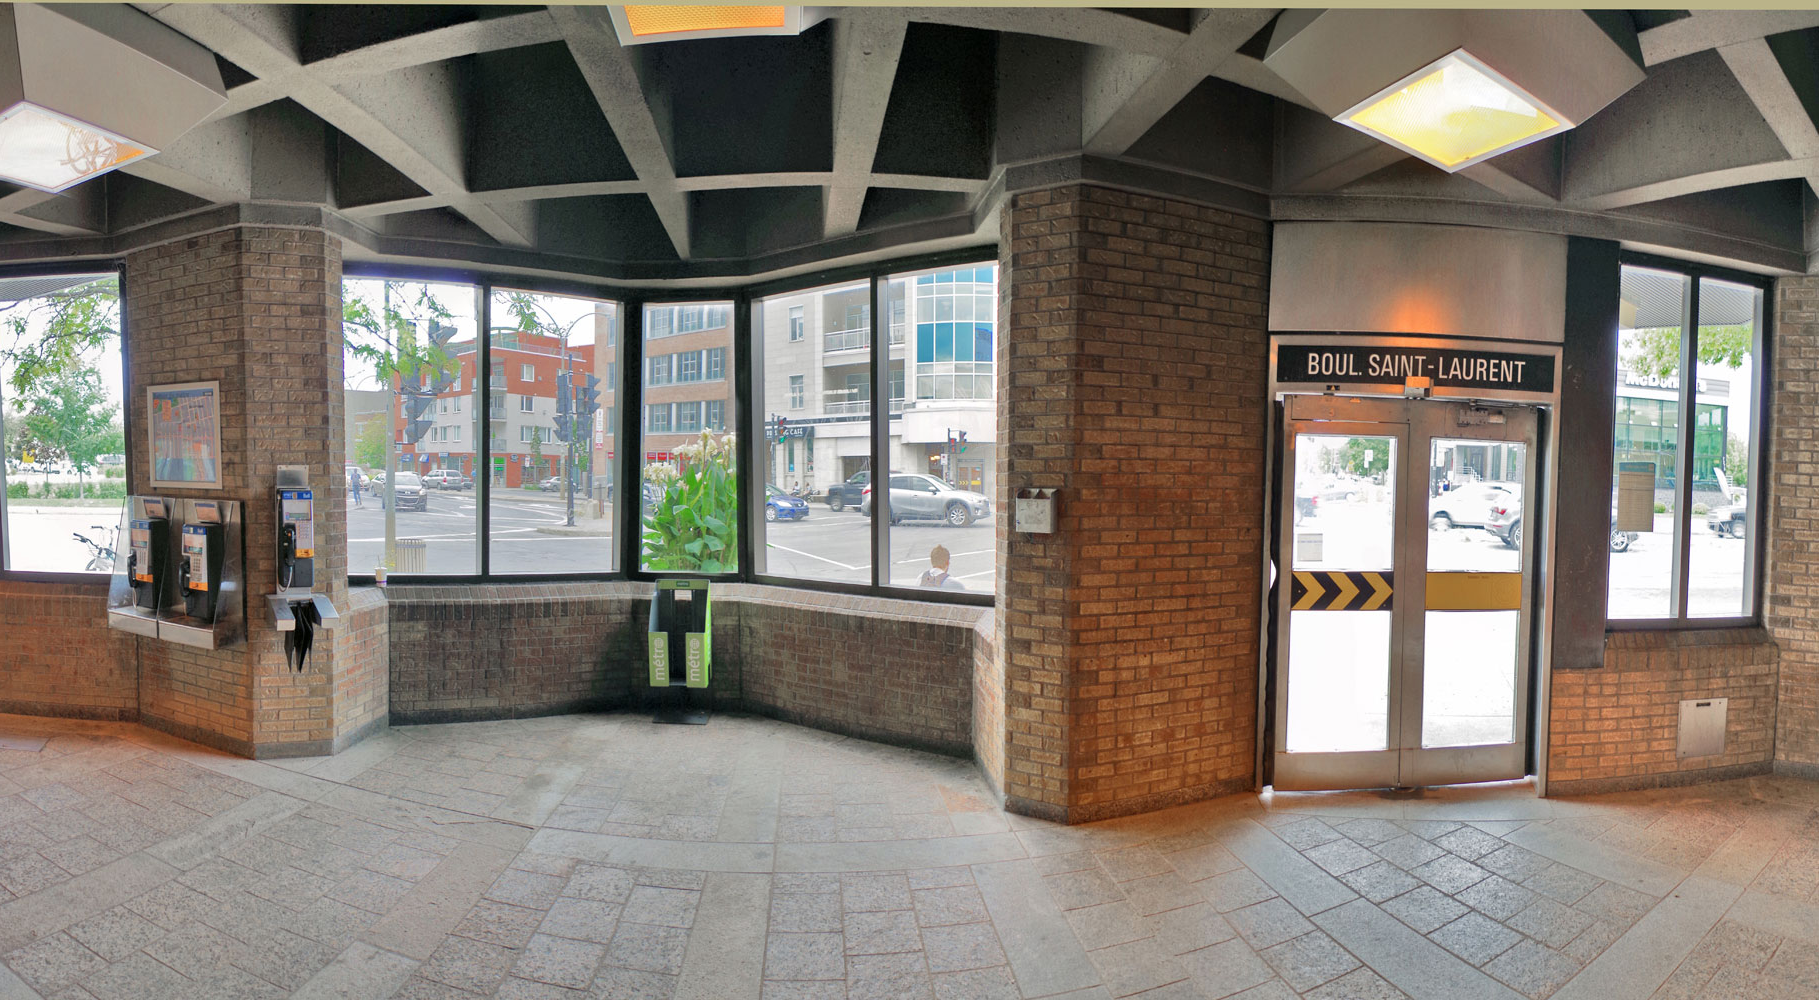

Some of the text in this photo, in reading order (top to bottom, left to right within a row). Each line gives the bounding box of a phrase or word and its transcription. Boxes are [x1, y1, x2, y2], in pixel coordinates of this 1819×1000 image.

[1307, 352, 1526, 383] BOUL. SAINT-LAURENT
[653, 637, 665, 681] métro
[687, 638, 700, 682] métro
